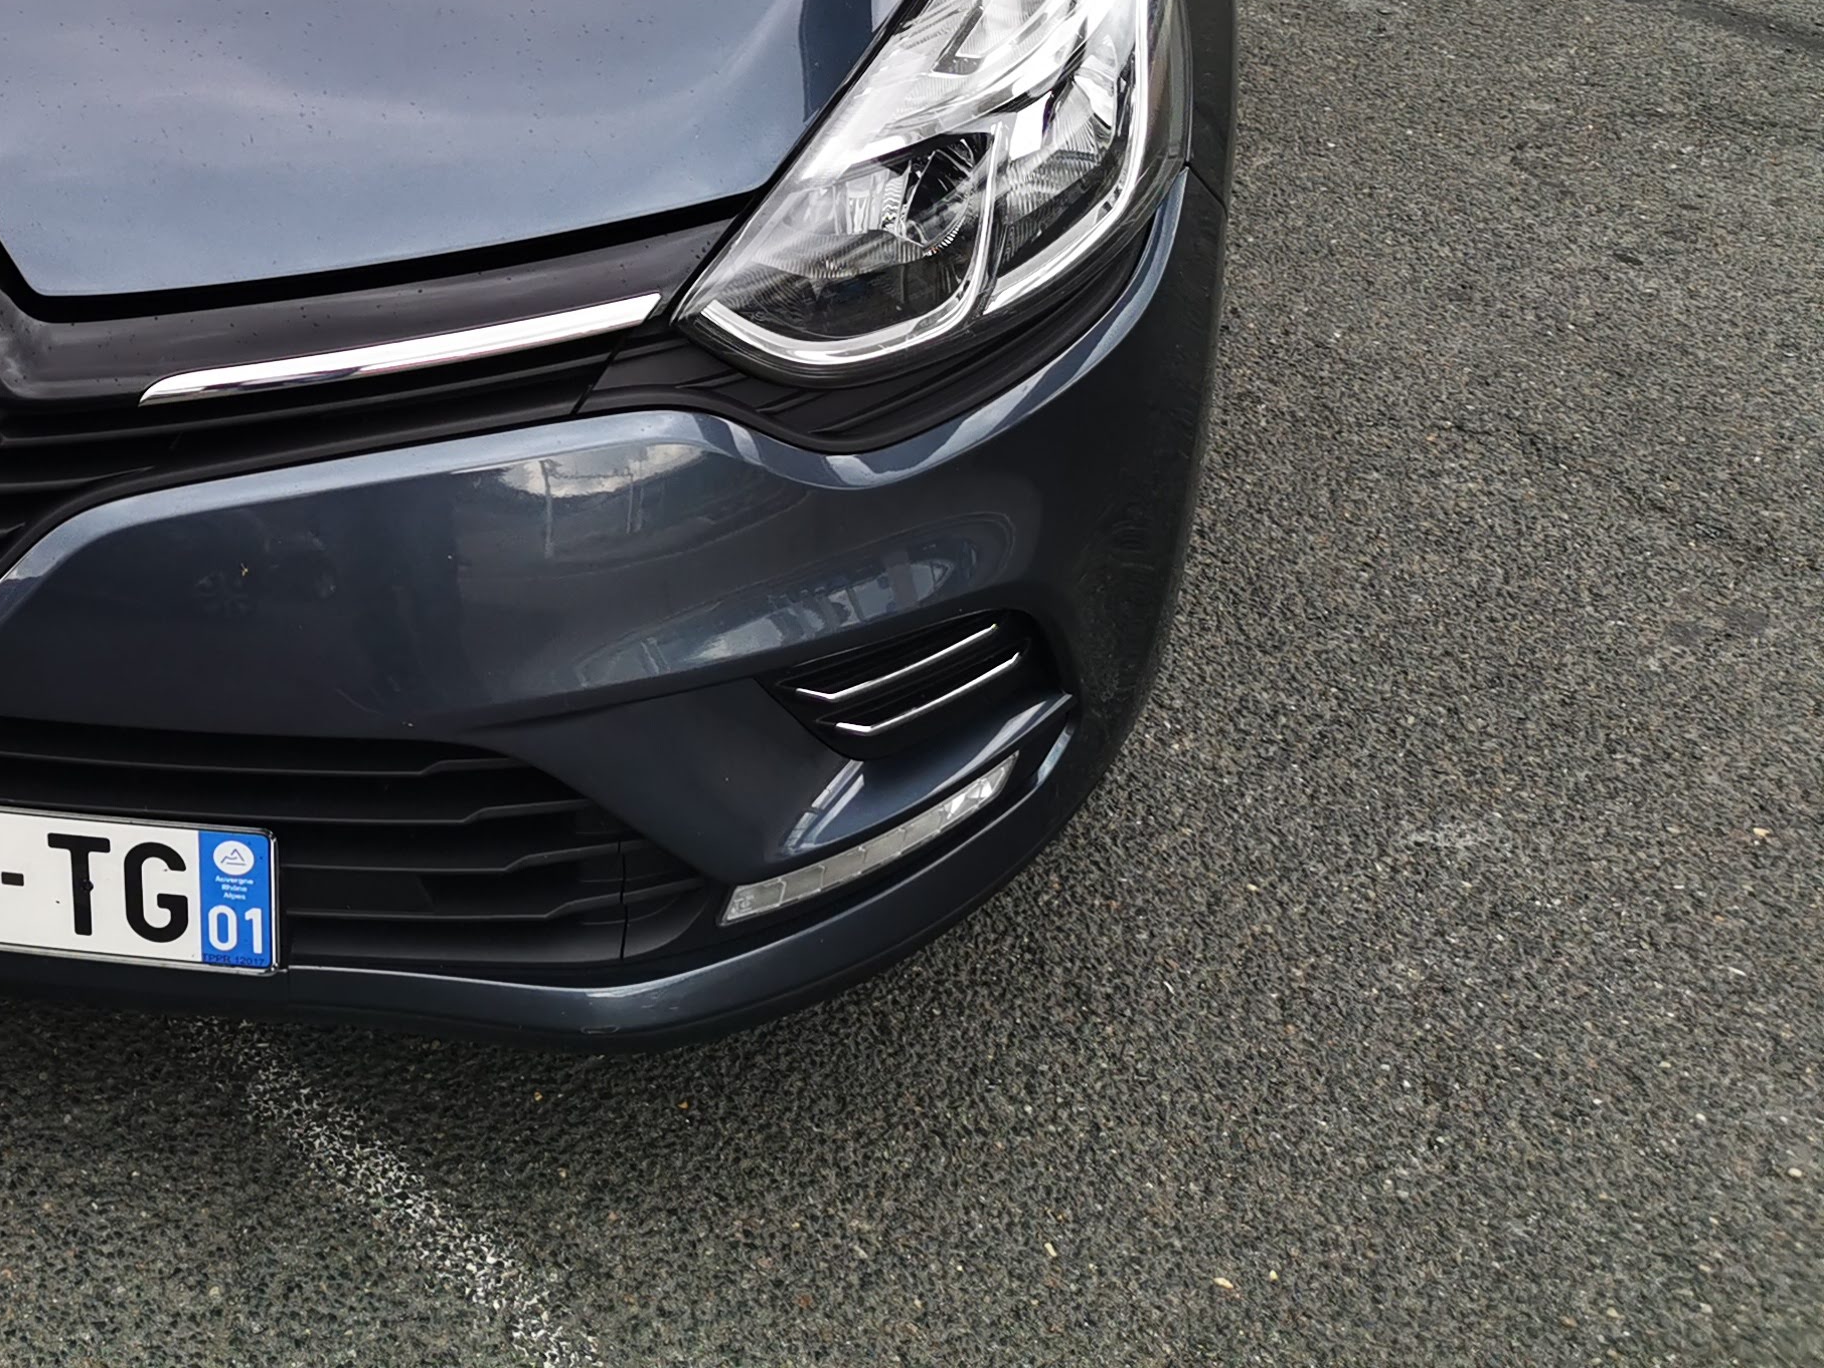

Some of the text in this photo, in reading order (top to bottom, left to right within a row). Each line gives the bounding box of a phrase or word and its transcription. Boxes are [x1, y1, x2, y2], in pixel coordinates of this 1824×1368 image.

[215, 875, 254, 885] Auvergne
[221, 884, 247, 892] Rhône
[223, 892, 246, 900] Alpes
[208, 904, 263, 954] 01
